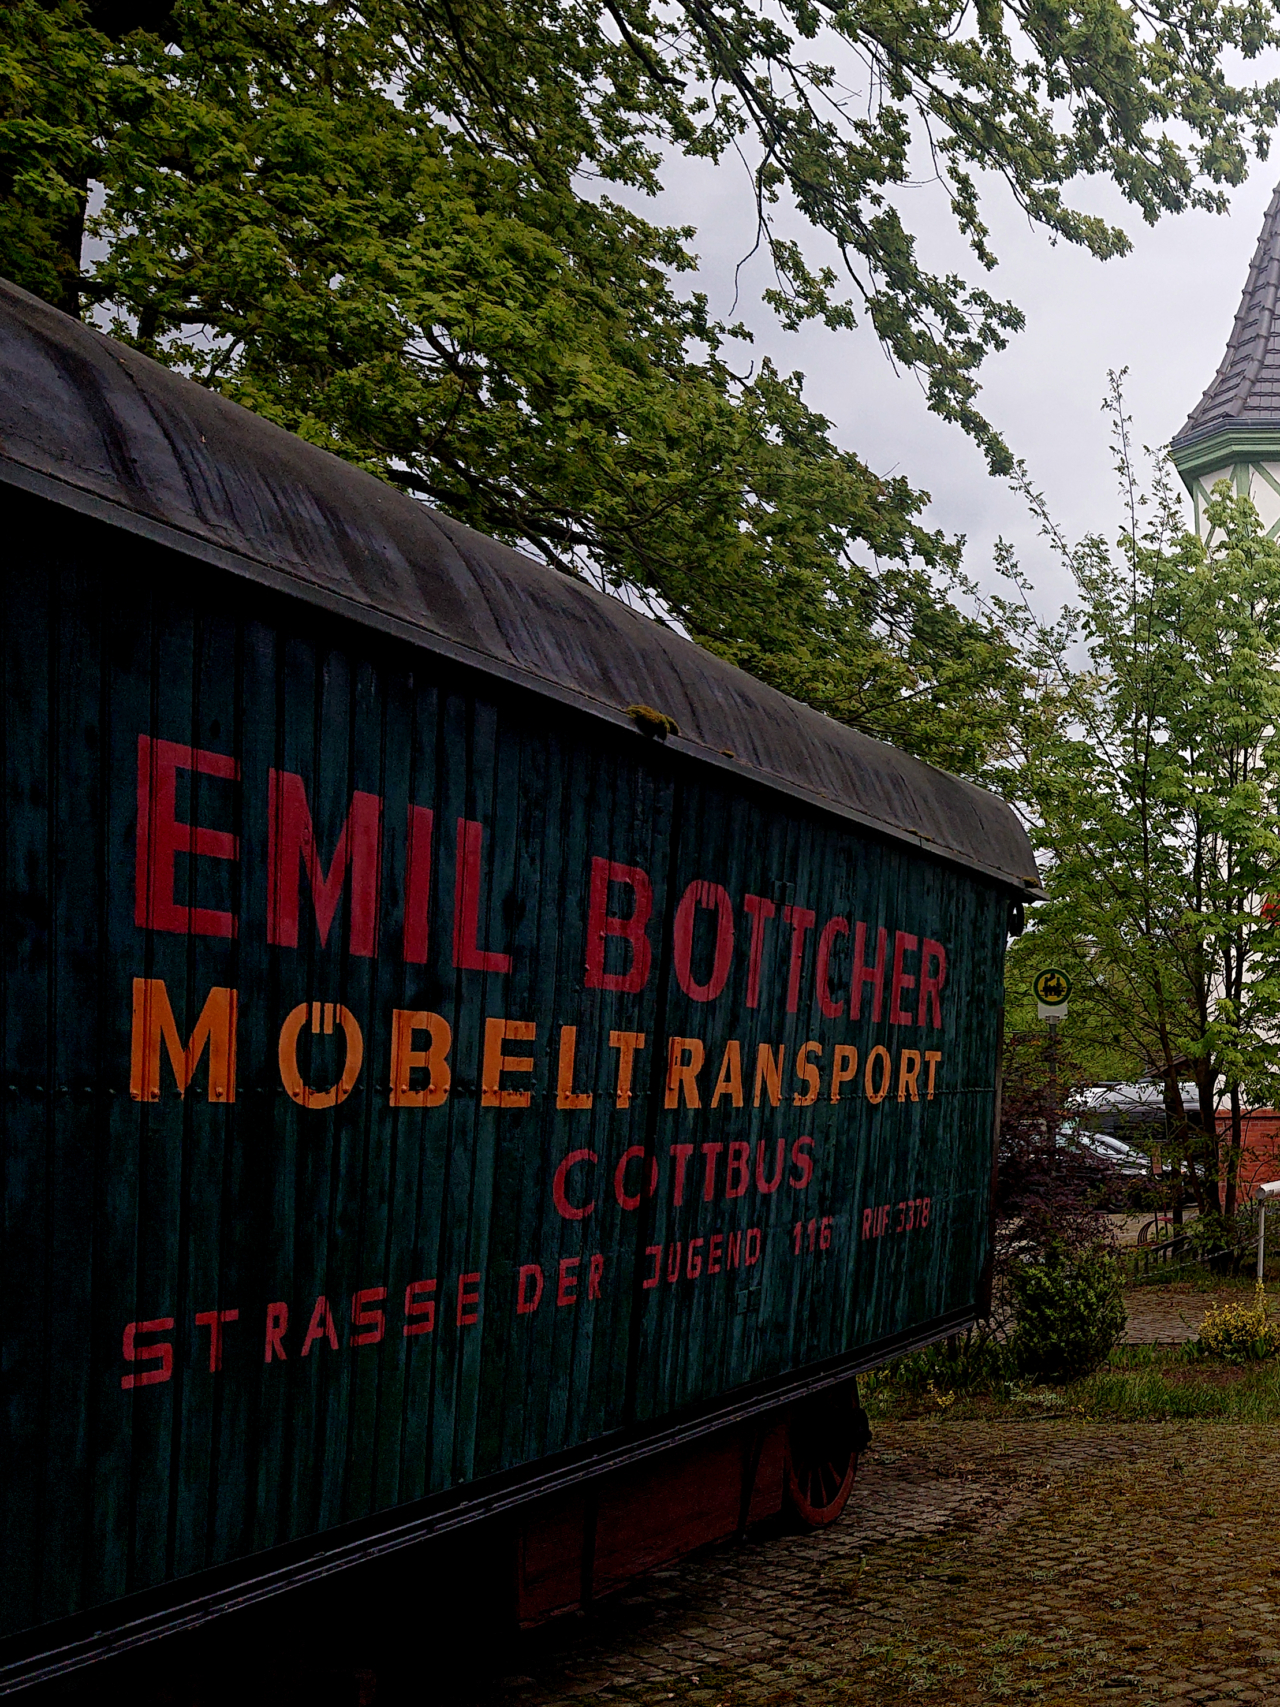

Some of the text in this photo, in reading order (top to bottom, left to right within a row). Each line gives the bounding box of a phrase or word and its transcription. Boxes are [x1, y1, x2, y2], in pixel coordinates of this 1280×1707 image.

[134, 733, 947, 1029] EMIL BÖTTCHER
[129, 977, 942, 1110] MÖBELTRANSPORT
[552, 1136, 816, 1221] COTTBUS
[121, 1272, 481, 1389] STRASSE
[516, 1254, 603, 1315] DER
[642, 1227, 761, 1289] JUGEND
[793, 1215, 833, 1255] 116
[896, 1196, 931, 1232] 3378
